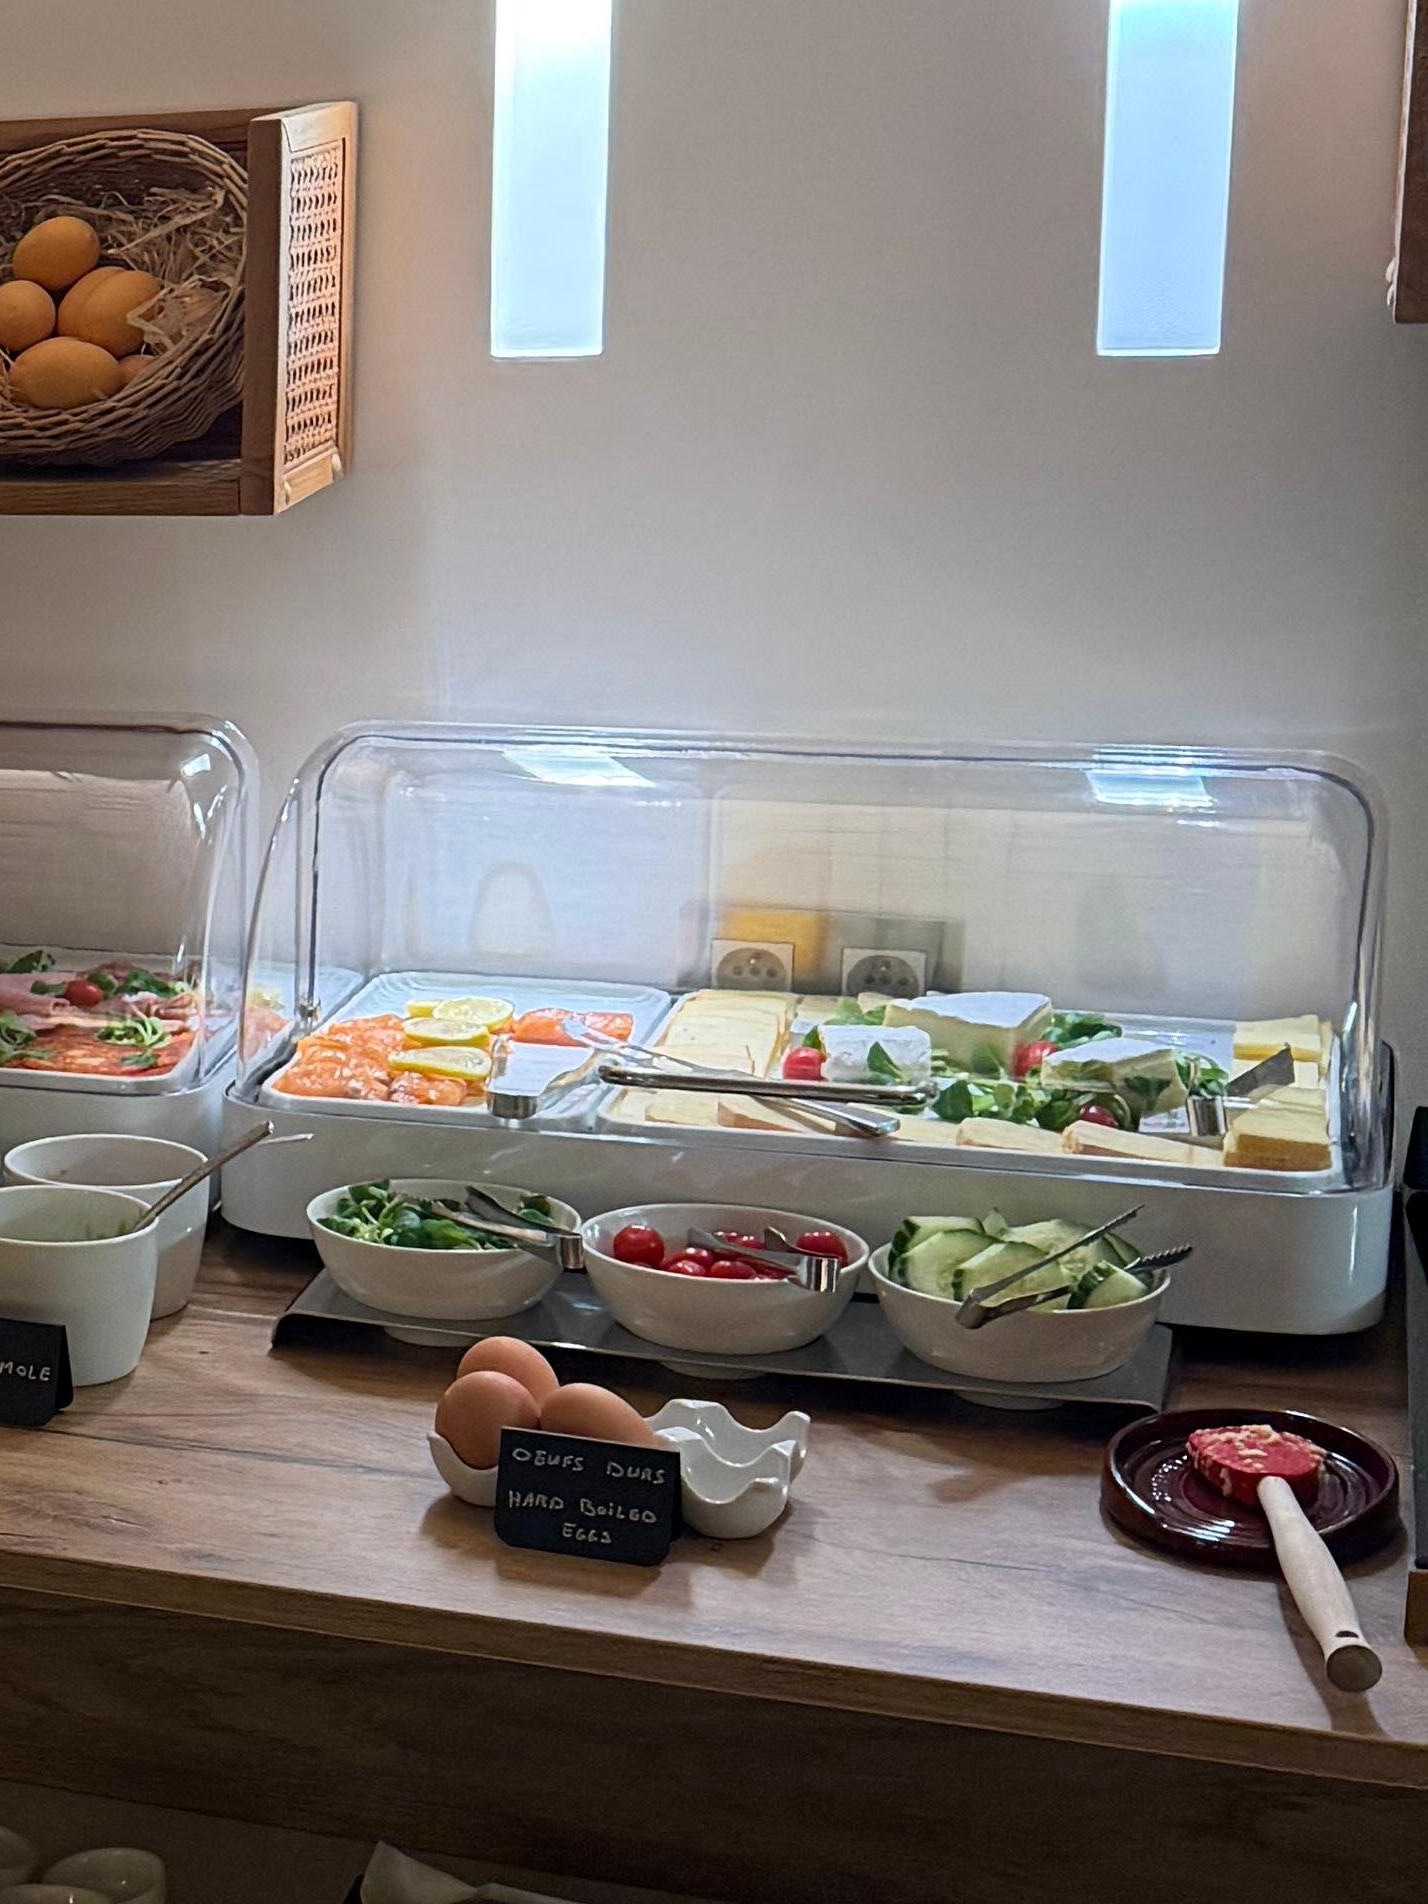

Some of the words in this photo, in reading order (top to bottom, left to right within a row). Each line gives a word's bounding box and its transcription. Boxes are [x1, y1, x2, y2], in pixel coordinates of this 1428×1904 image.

[511, 1447, 585, 1472] OEUFS
[606, 1461, 667, 1485] DURS
[508, 1489, 565, 1510] HARD
